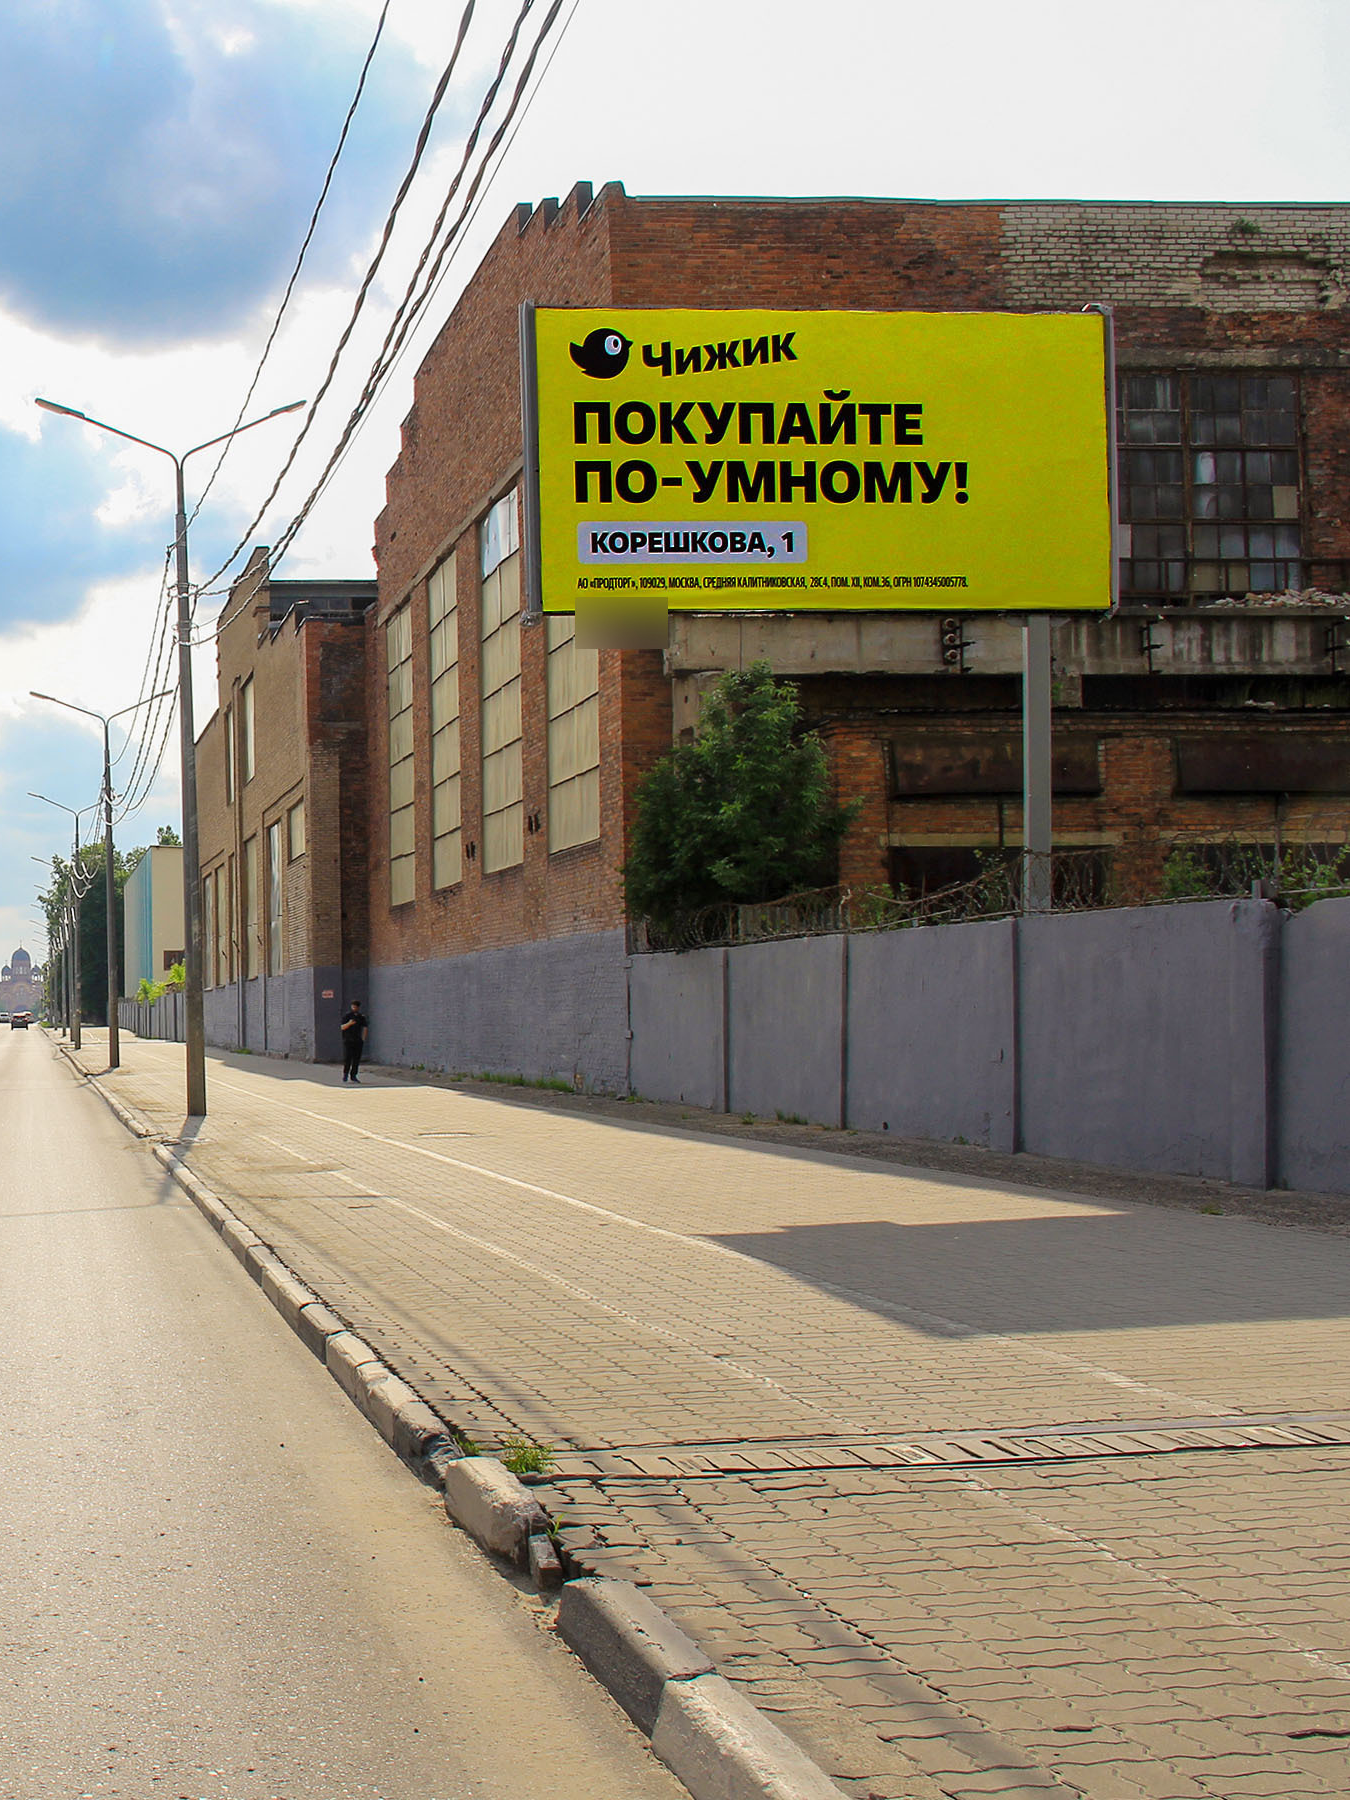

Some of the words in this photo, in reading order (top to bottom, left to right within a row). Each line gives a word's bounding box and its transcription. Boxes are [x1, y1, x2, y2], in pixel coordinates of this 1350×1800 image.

[641, 331, 798, 377] Чижик
[573, 389, 924, 446] ПОКУПАЙТЕ
[573, 459, 970, 505] ПО-УМНОМУ!
[590, 530, 776, 558] КОРЕШКОВА,
[782, 531, 795, 554] 1
[577, 577, 589, 589] АО
[639, 577, 668, 590] 109029,
[668, 577, 702, 590] МОСКВА,
[703, 576, 737, 589] СРЕДНЯЯ
[737, 576, 808, 589] КАЛИТНИКОВСКАЯ,
[893, 576, 912, 588] ОГРН
